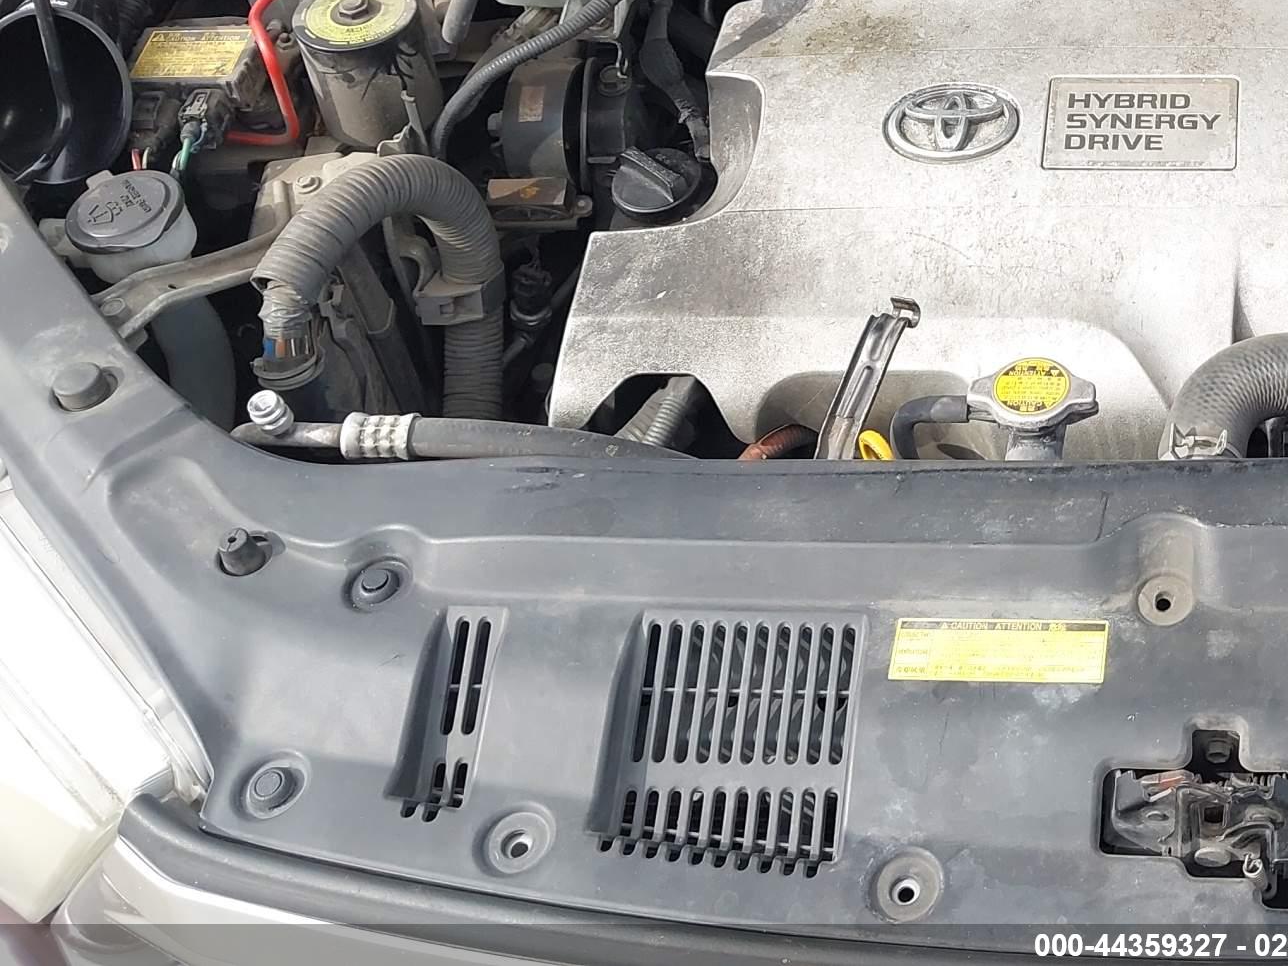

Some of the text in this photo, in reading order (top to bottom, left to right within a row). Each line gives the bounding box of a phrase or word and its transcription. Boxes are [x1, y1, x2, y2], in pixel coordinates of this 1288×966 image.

[1068, 93, 1191, 109] HYBRID
[1066, 113, 1221, 130] SYNERGY
[1064, 133, 1164, 151] DRIVE
[950, 623, 989, 631] CAUTION
[995, 623, 1042, 631] ATTENTION
